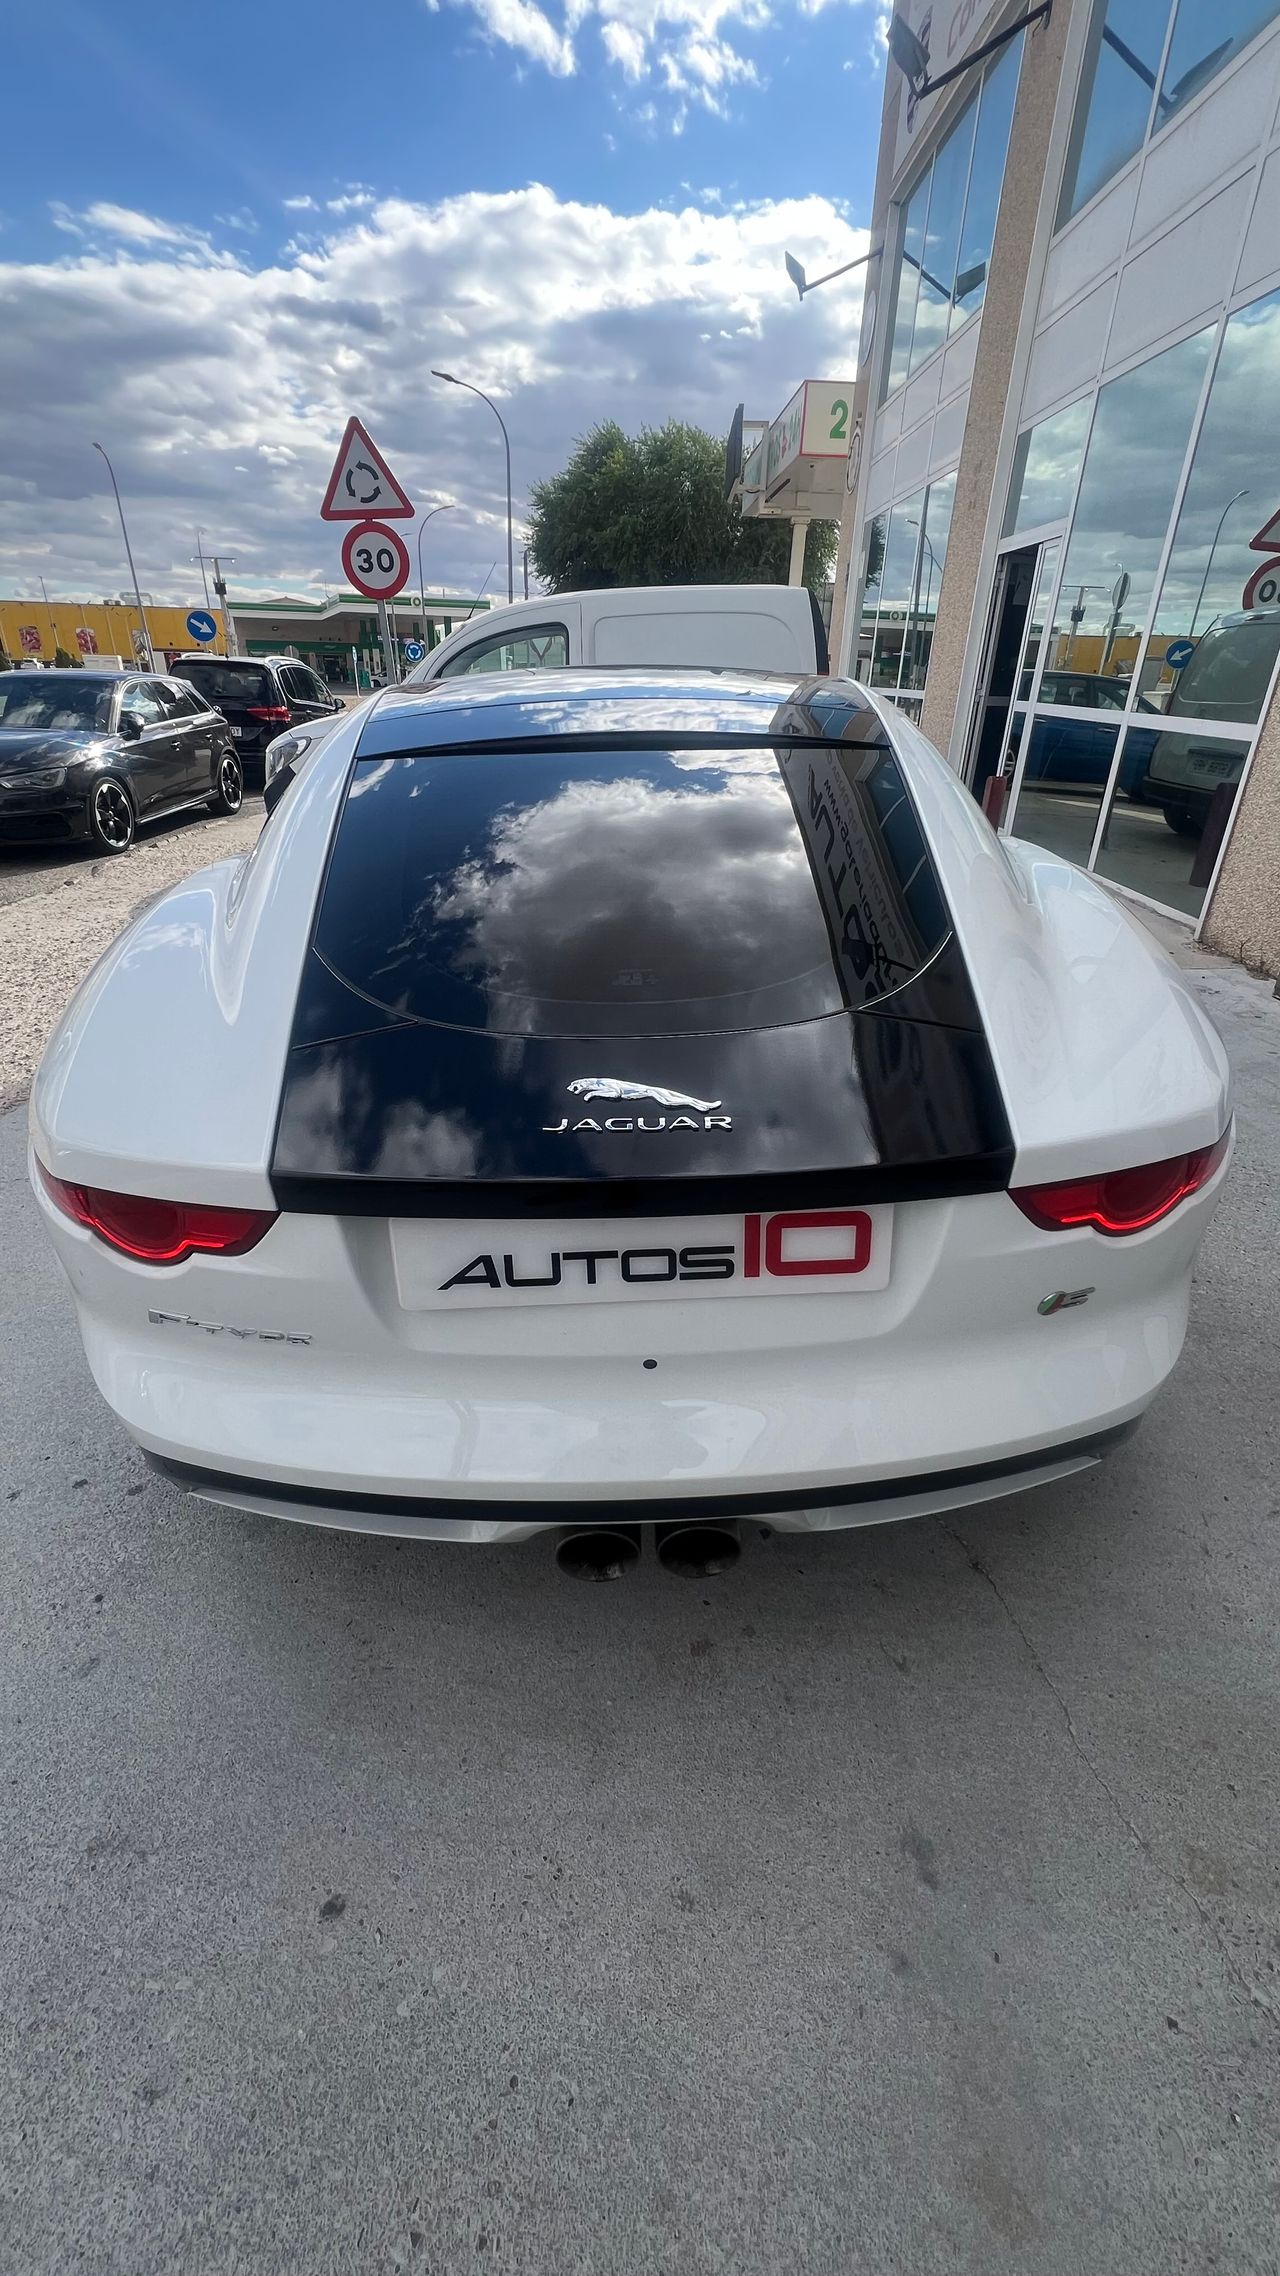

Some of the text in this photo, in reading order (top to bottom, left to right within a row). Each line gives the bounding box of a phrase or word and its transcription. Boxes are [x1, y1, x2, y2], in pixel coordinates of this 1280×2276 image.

[829, 399, 849, 439] 2
[356, 548, 394, 573] 30
[543, 1115, 733, 1132] JAGUAR
